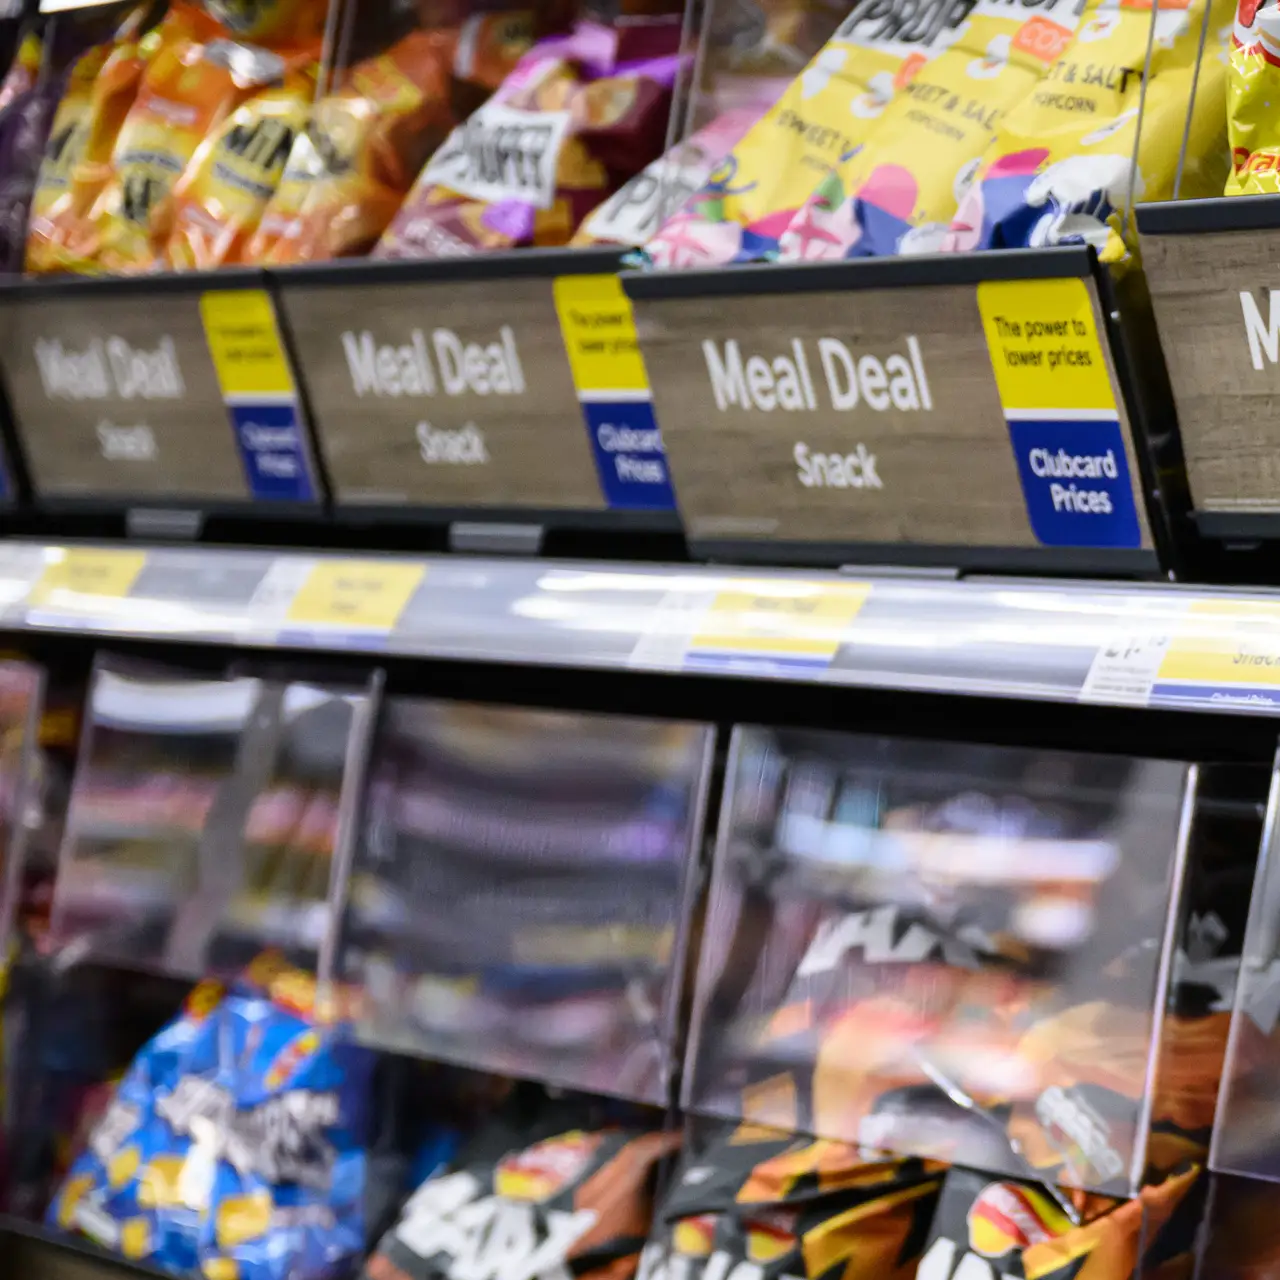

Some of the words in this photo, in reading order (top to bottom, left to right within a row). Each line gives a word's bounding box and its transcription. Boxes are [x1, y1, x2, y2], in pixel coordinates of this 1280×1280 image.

[994, 317, 1021, 338] The
[1025, 318, 1067, 342] power
[1070, 317, 1086, 335] to
[342, 331, 434, 396] Meal
[433, 327, 524, 394] Deal
[703, 339, 816, 410] Meal
[819, 336, 932, 410] Deal
[1002, 345, 1044, 369] lower
[1048, 346, 1092, 371] prices
[415, 421, 488, 465] Snack
[794, 444, 883, 489] Snack
[1029, 447, 1117, 479] Clubcard
[1051, 484, 1112, 513] Prices
